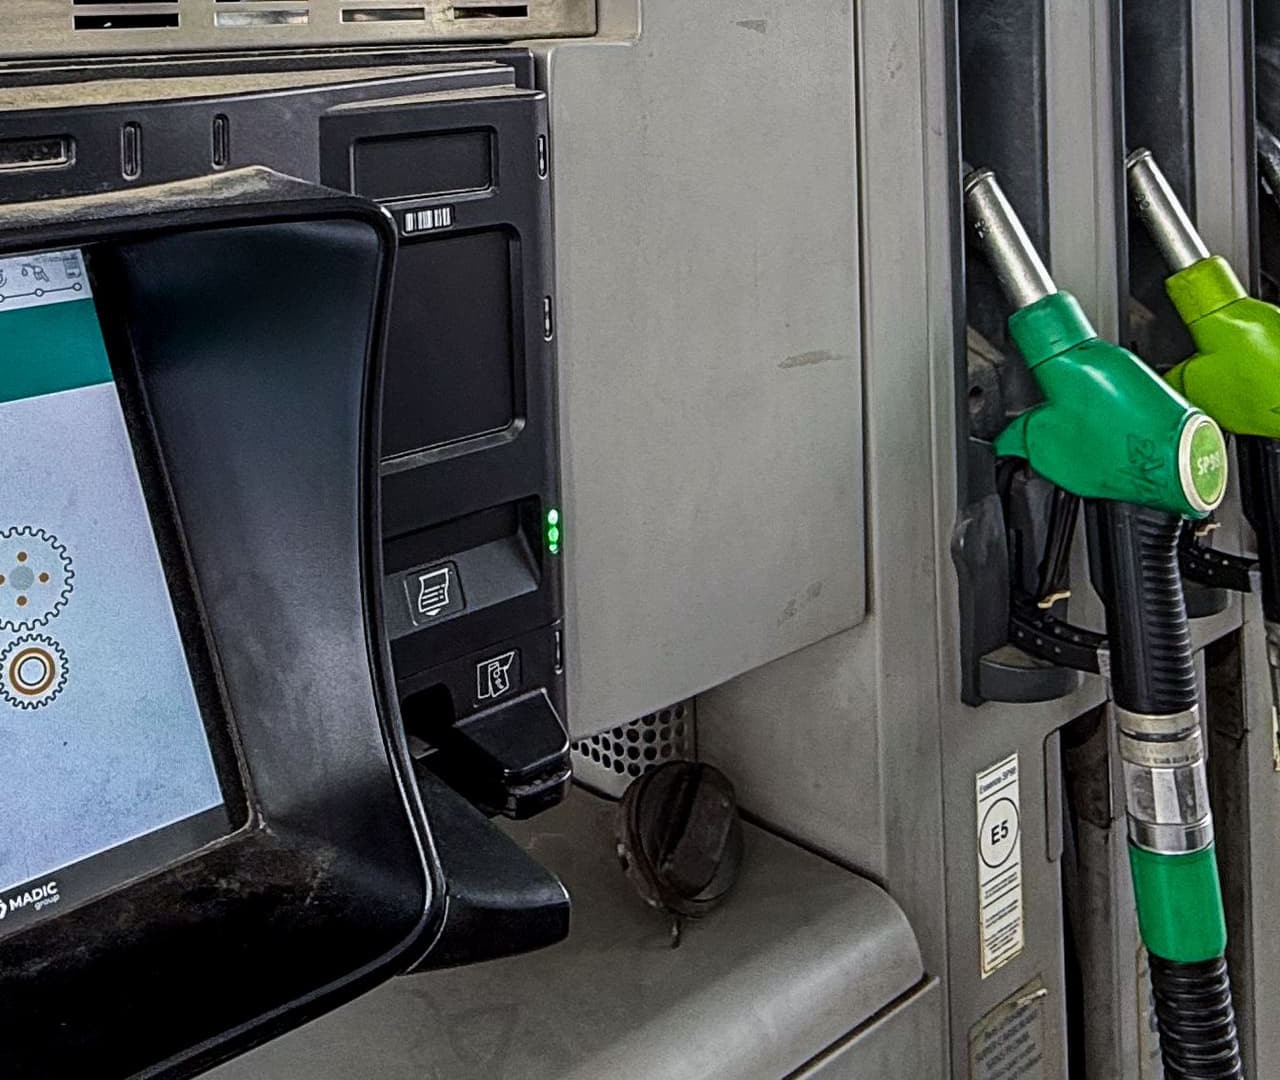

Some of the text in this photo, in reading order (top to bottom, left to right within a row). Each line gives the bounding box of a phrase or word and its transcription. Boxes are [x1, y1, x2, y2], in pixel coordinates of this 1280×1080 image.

[990, 819, 1009, 846] E5
[8, 881, 58, 912] MADIC
[33, 893, 61, 911] group
